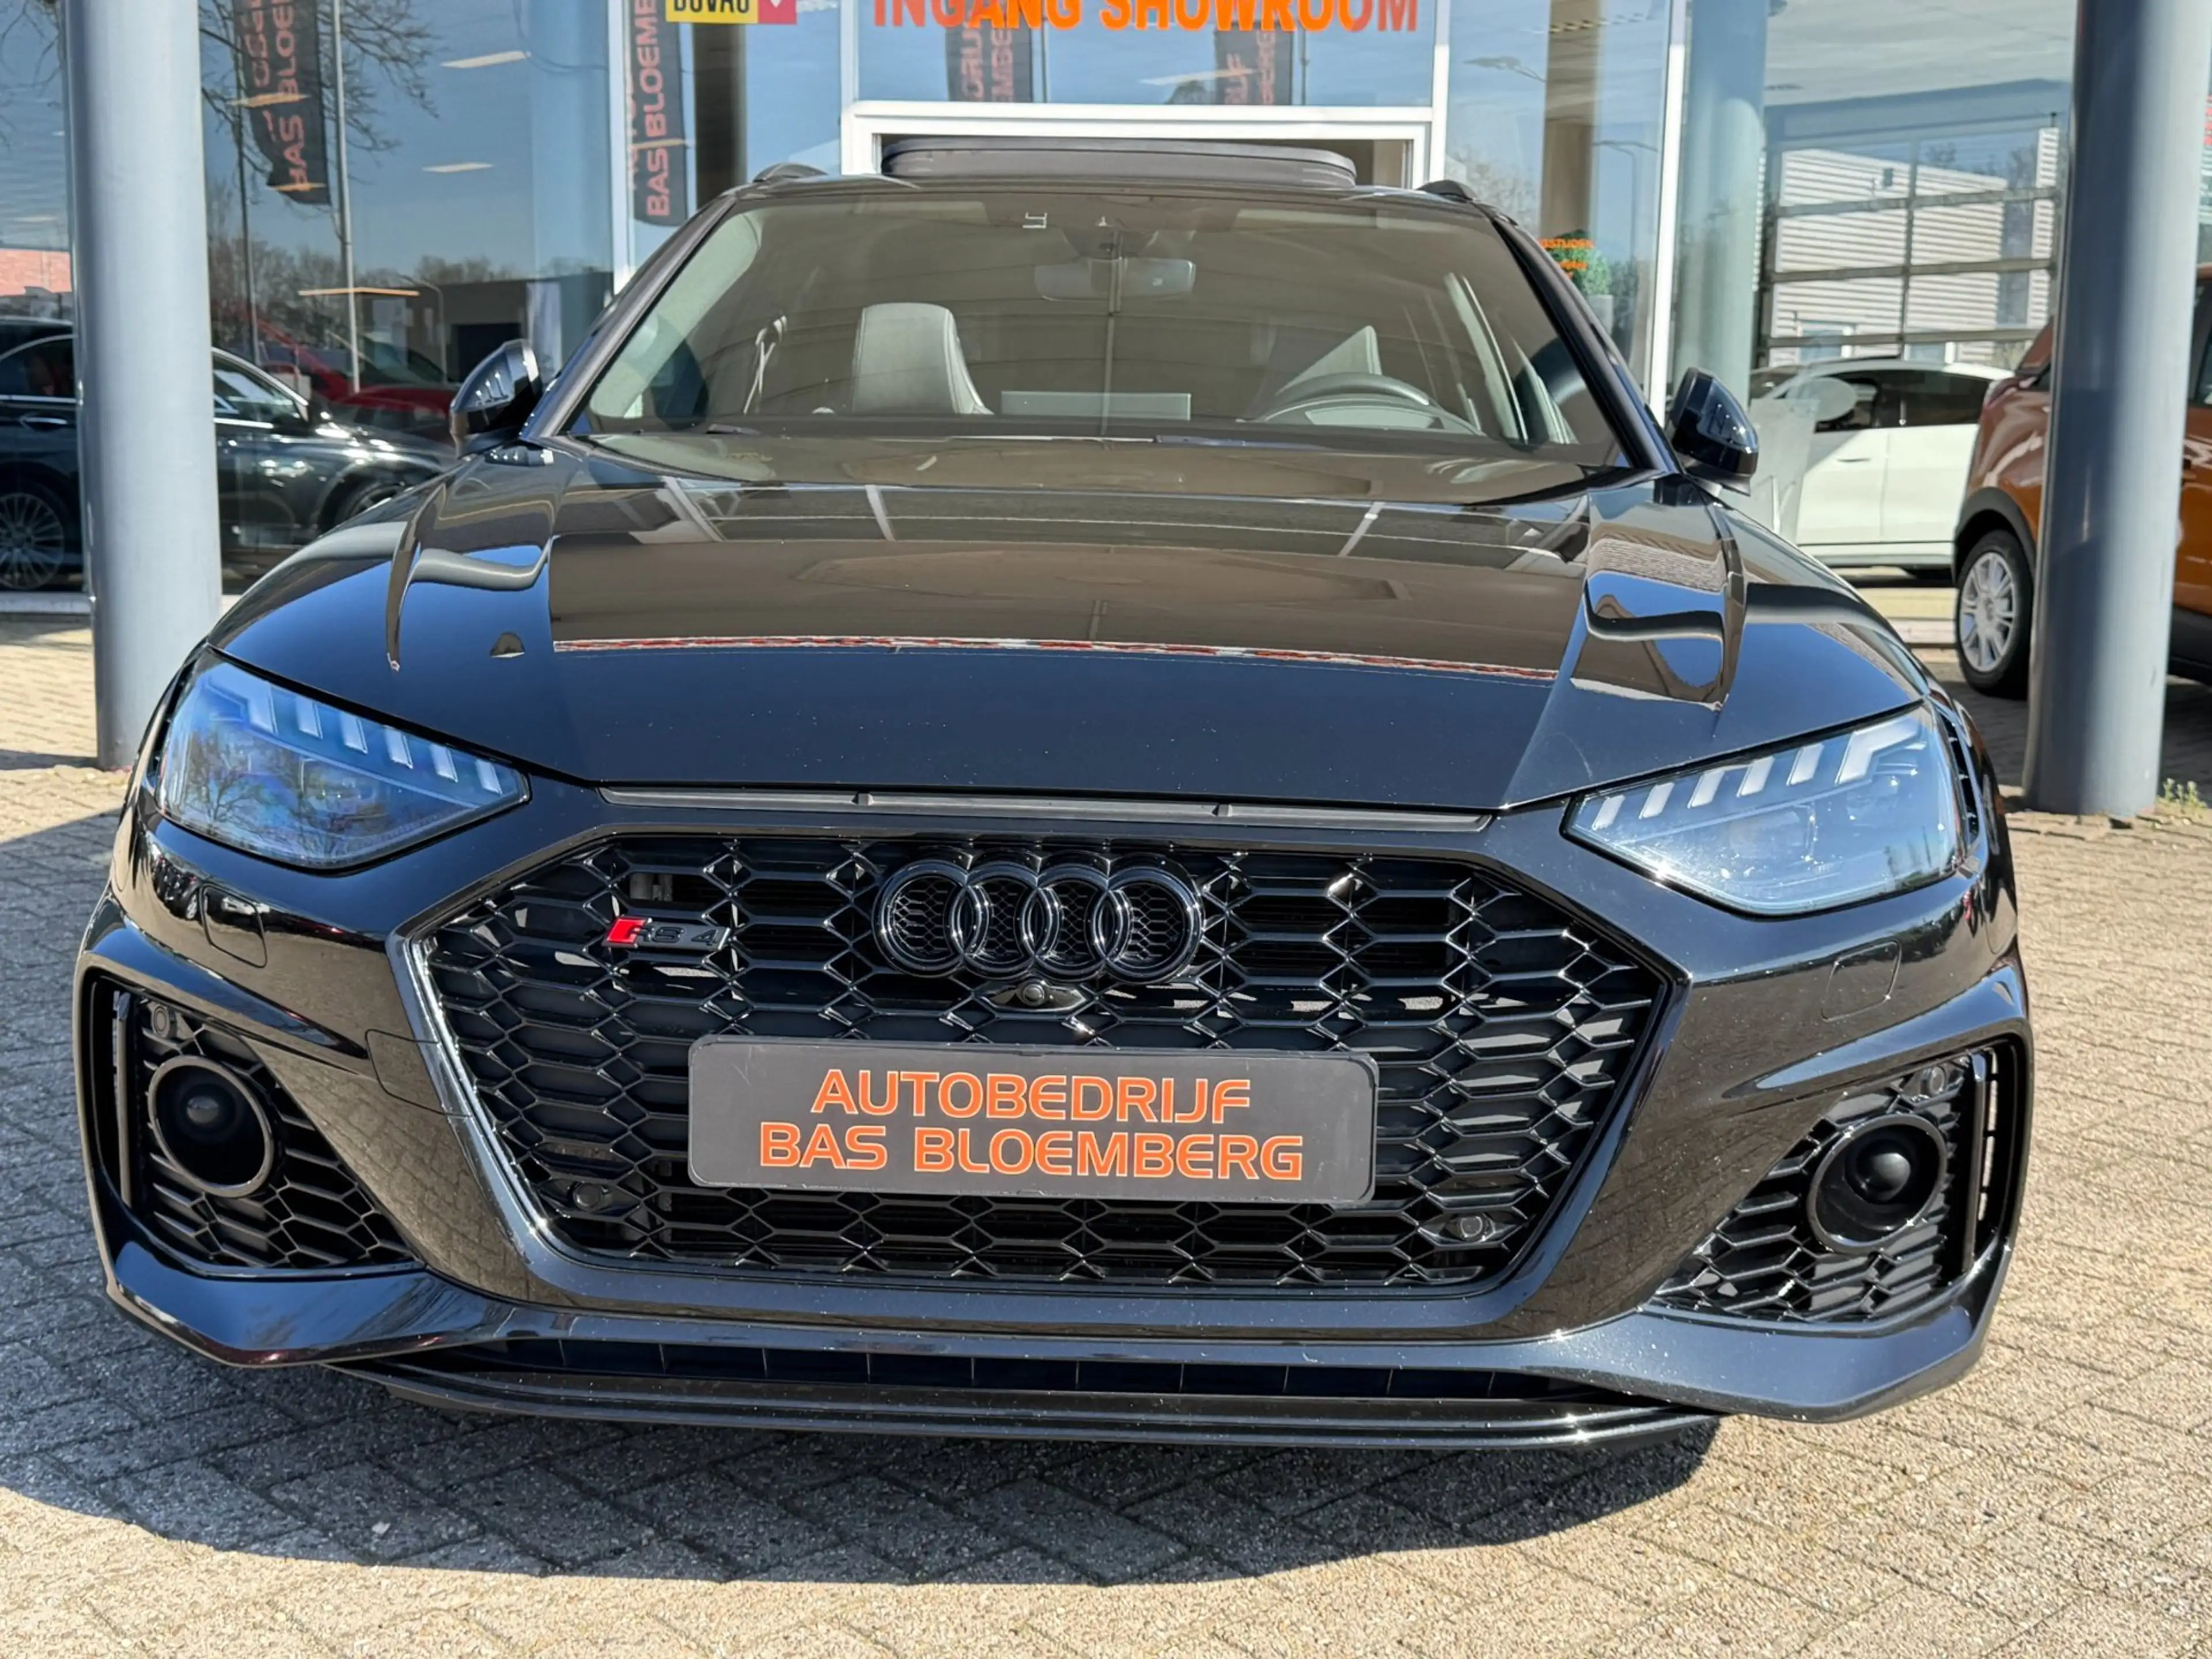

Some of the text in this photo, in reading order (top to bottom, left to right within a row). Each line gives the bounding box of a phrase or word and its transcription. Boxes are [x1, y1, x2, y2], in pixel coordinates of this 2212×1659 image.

[873, 0, 1418, 33] INGANG SHOWROOM
[647, 148, 670, 217] BAS
[810, 1069, 1251, 1124] AUTOBEDRIJF
[759, 1121, 1304, 1181] BAS BLOEMBERG
